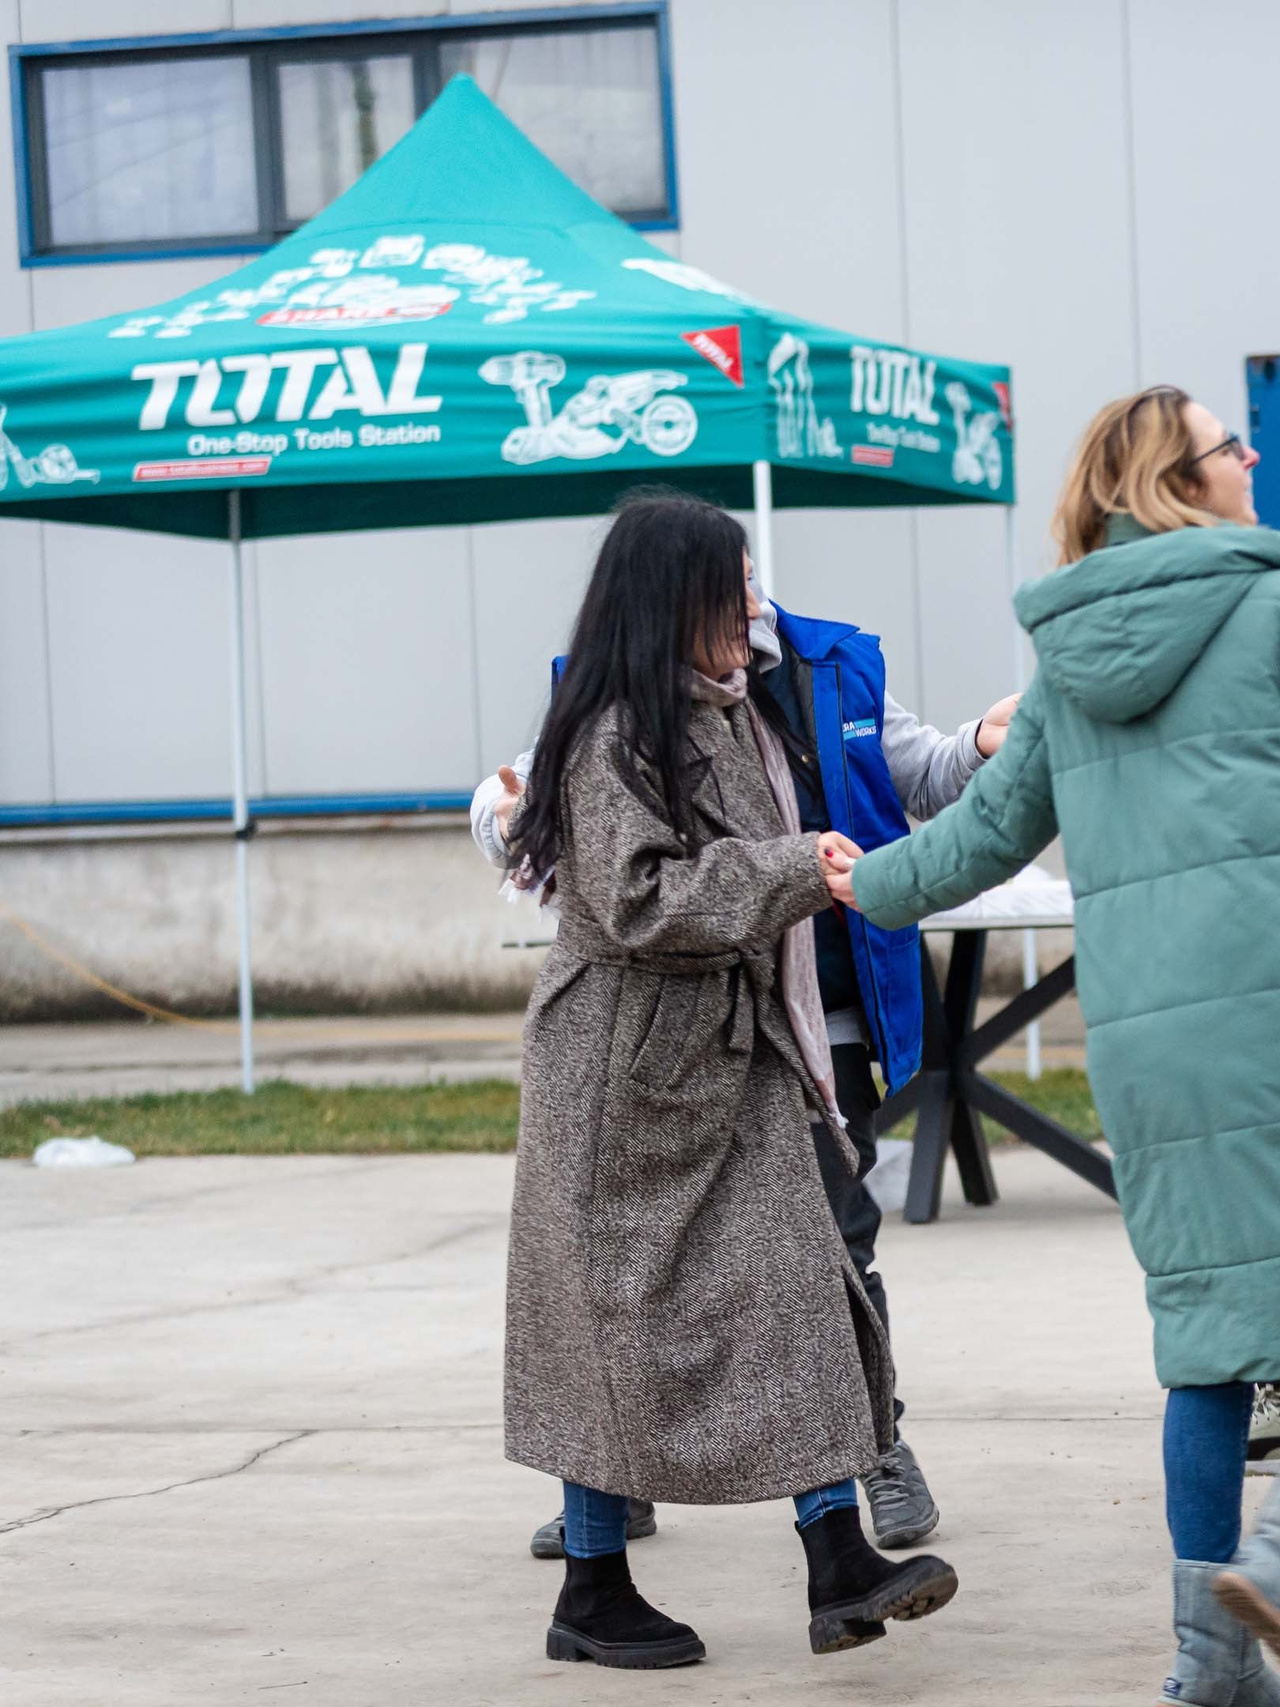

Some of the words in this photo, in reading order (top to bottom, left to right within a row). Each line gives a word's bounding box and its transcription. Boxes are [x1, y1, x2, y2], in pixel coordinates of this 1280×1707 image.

[131, 342, 442, 431] TOTAL
[850, 346, 940, 426] TOTAL
[187, 431, 289, 456] One-Stop
[293, 426, 354, 450] Tools
[358, 421, 441, 447] Station
